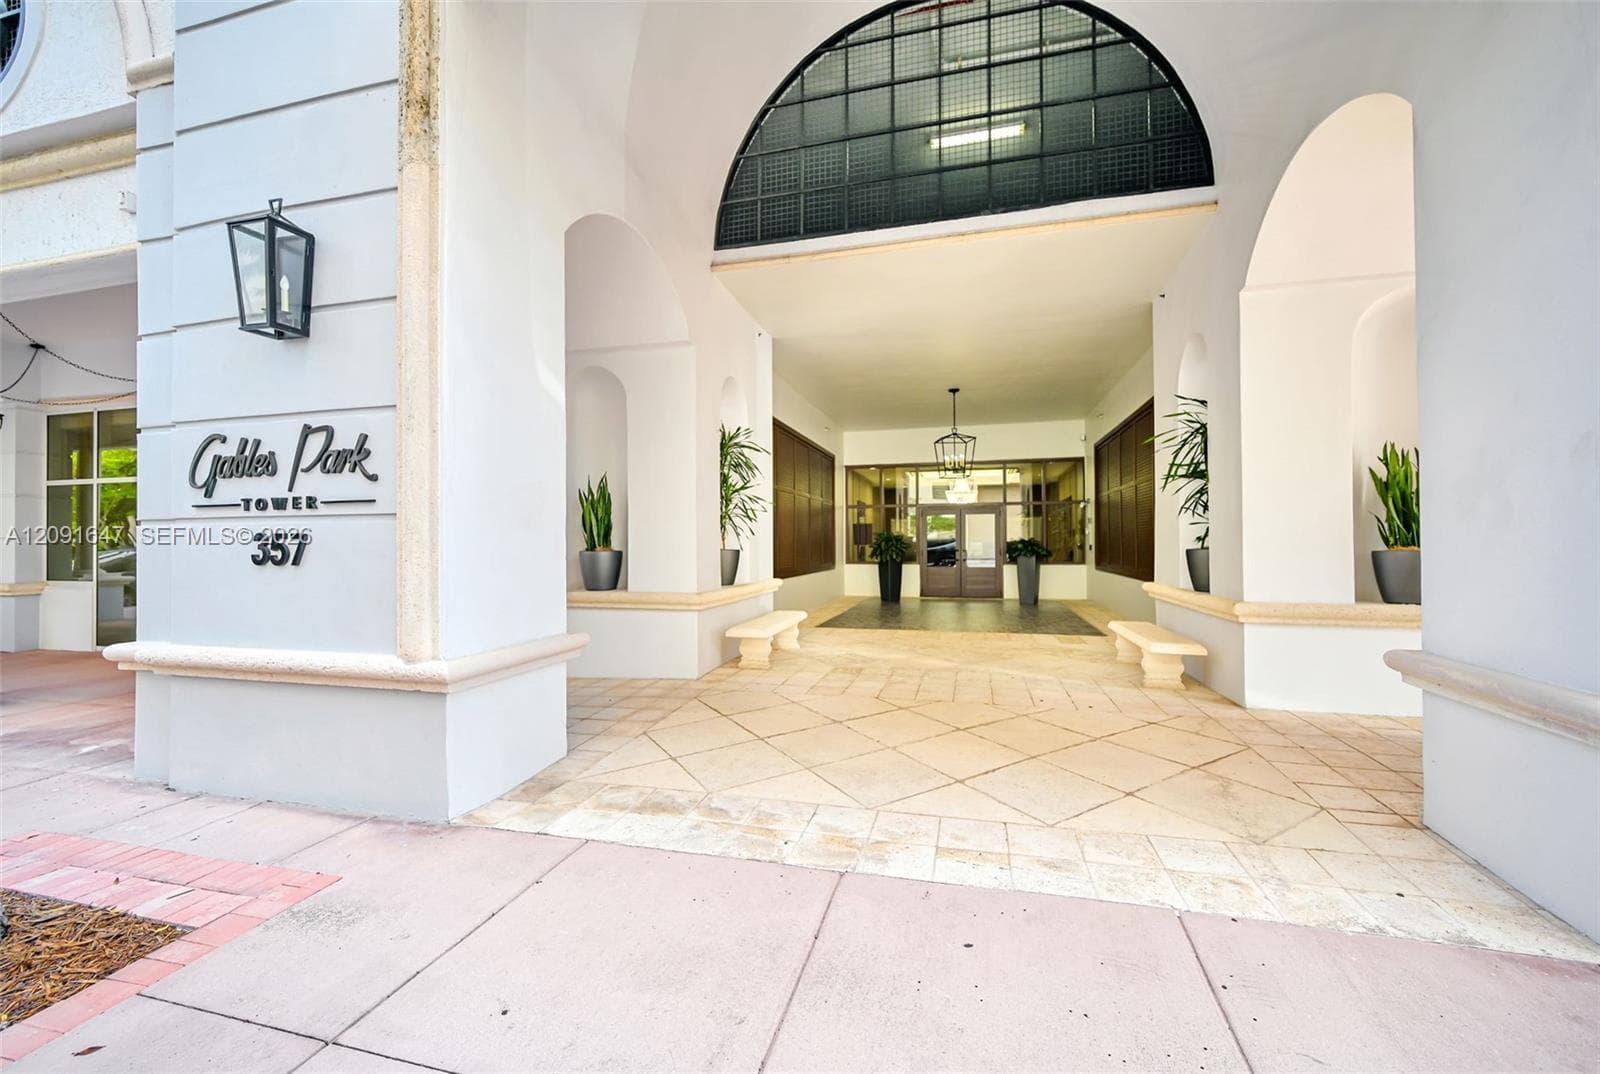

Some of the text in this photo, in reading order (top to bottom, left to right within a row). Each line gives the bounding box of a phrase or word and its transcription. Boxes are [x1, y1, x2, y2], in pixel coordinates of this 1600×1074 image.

[188, 423, 379, 498] Gables Park
[240, 496, 318, 511] TOWER
[251, 532, 307, 566] 357
